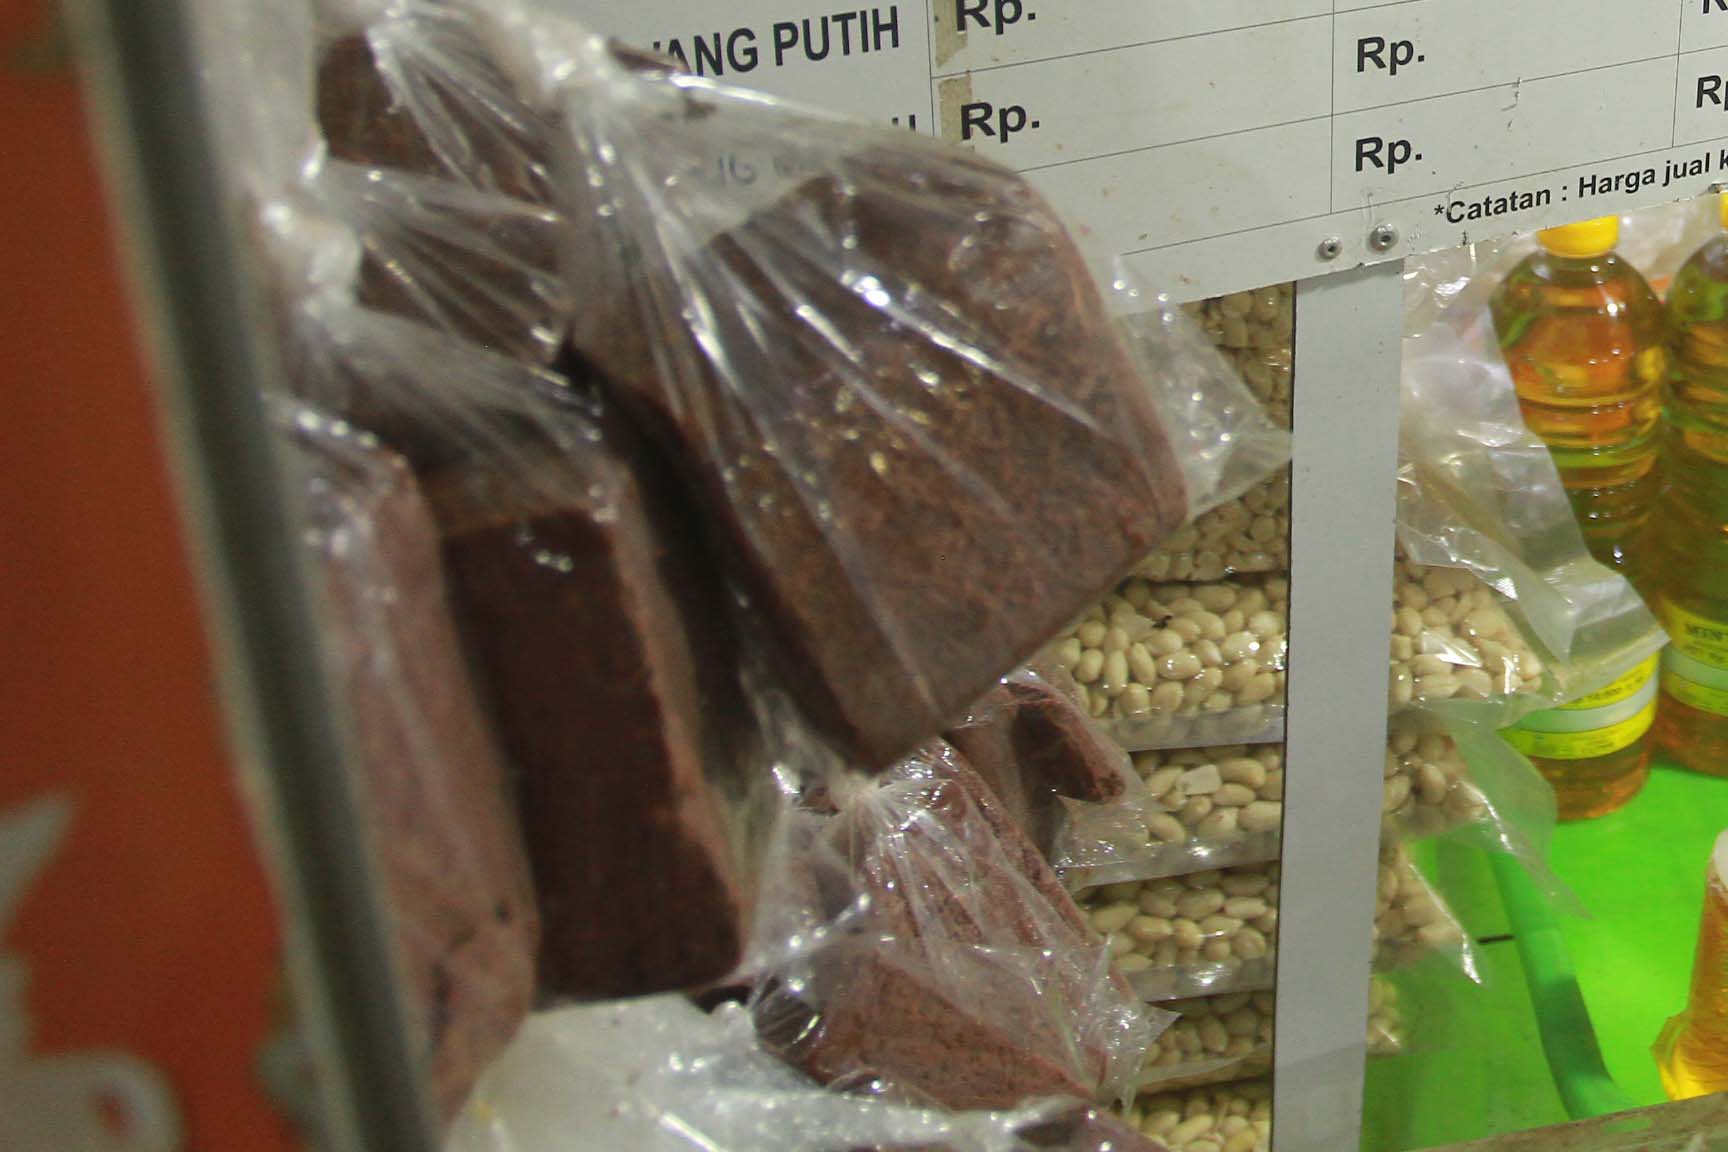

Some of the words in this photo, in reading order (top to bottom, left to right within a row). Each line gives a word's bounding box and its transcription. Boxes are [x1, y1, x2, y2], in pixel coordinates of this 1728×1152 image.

[772, 5, 899, 67] PUTIH
[1357, 36, 1425, 76] Rp.
[960, 101, 1040, 144] Rp.
[1355, 136, 1422, 175] Rp.
[1577, 174, 1656, 199] Harga
[1662, 152, 1711, 187] jual
